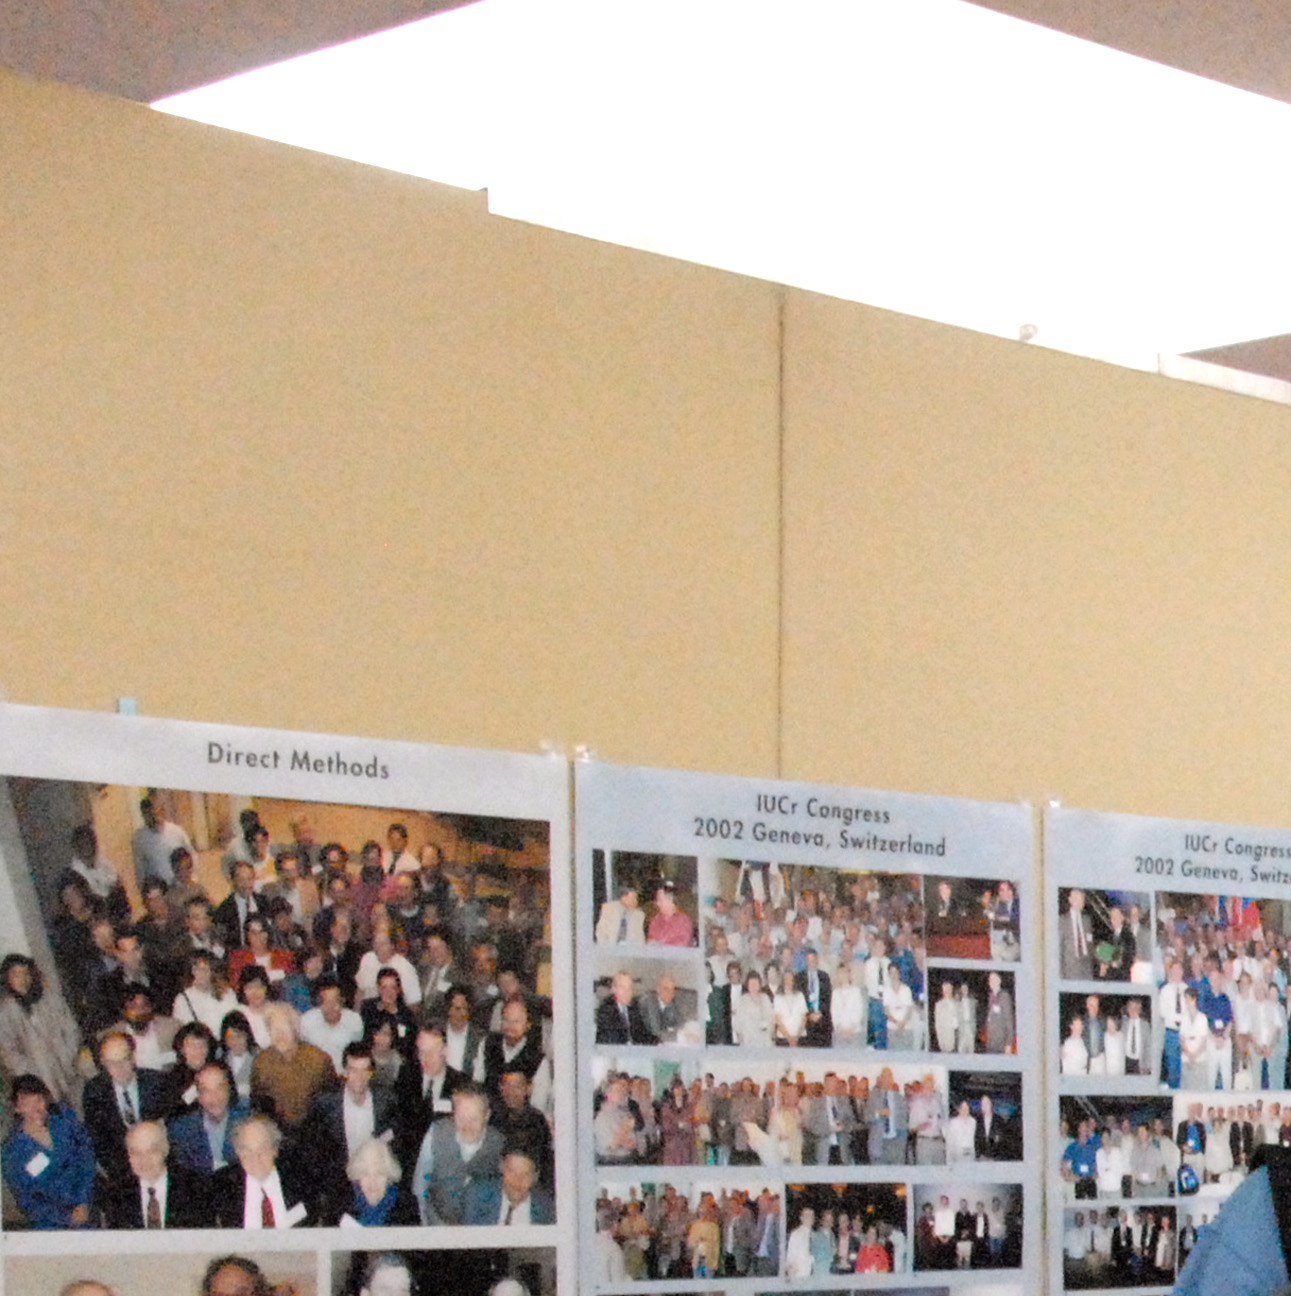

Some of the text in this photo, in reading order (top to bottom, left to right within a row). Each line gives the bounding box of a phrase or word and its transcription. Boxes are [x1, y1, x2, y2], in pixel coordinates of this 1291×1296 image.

[207, 741, 390, 780] Direct Methods
[756, 793, 891, 826] IUCr Congress
[693, 816, 947, 858] 2002 Geneva, Switzerland
[1184, 834, 1219, 853] IUCr
[1134, 855, 1175, 876] 2002
[1180, 859, 1244, 884] Geneva,
